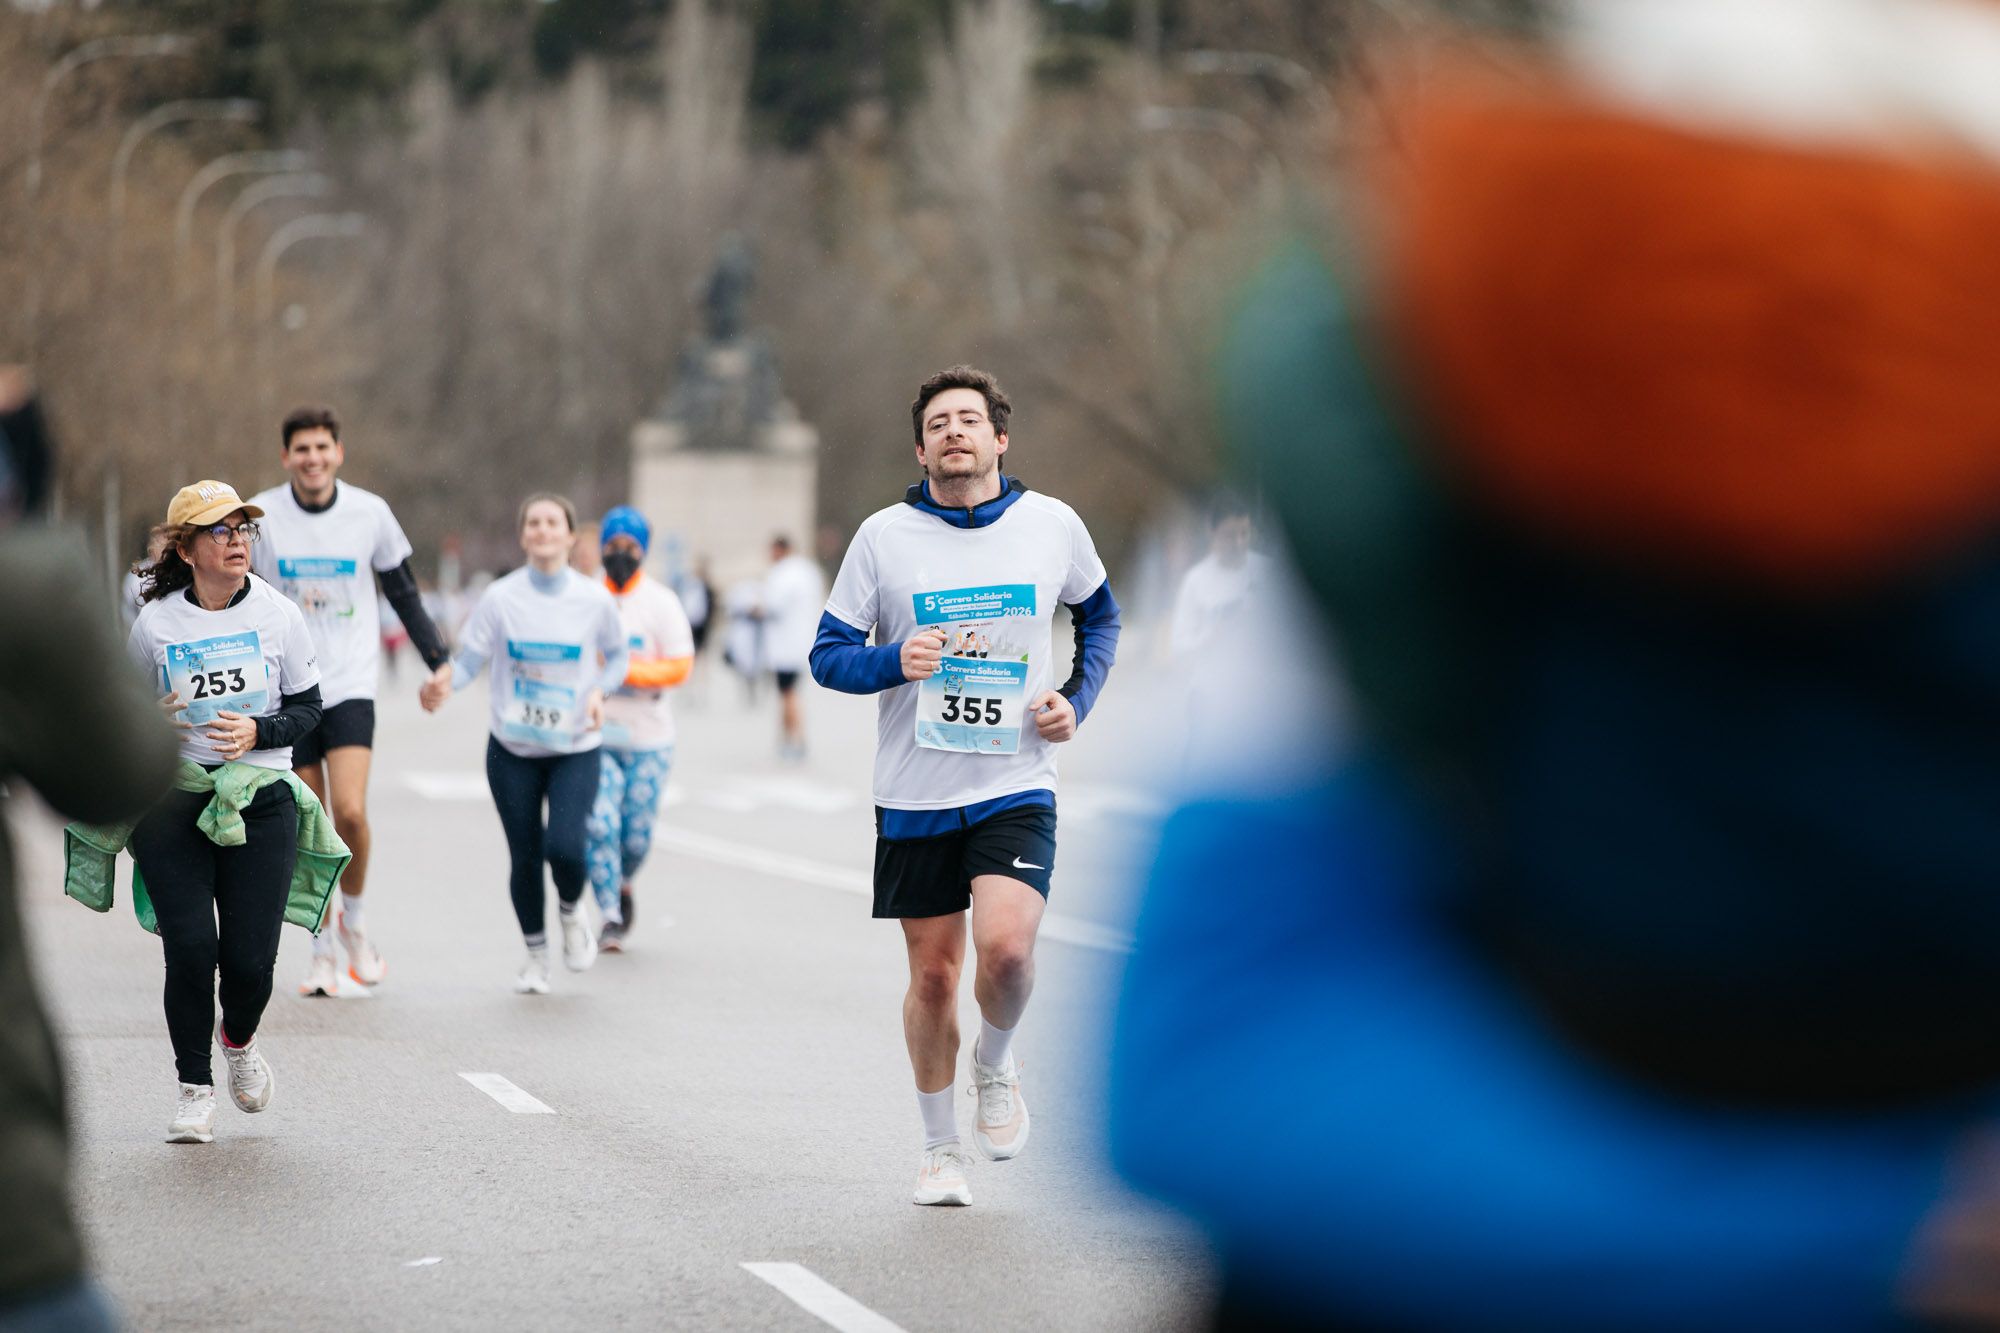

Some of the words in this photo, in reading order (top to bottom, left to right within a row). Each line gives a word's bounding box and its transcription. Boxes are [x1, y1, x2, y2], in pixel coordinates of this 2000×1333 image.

[938, 594, 972, 605] Carrera
[973, 591, 1012, 602] Solidaria
[1003, 606, 1031, 617] 2026
[212, 640, 244, 650] Solidaria
[945, 663, 975, 674] Carrera
[977, 666, 1012, 676] Solidaria
[190, 667, 246, 699] 253
[941, 694, 1002, 726] 355
